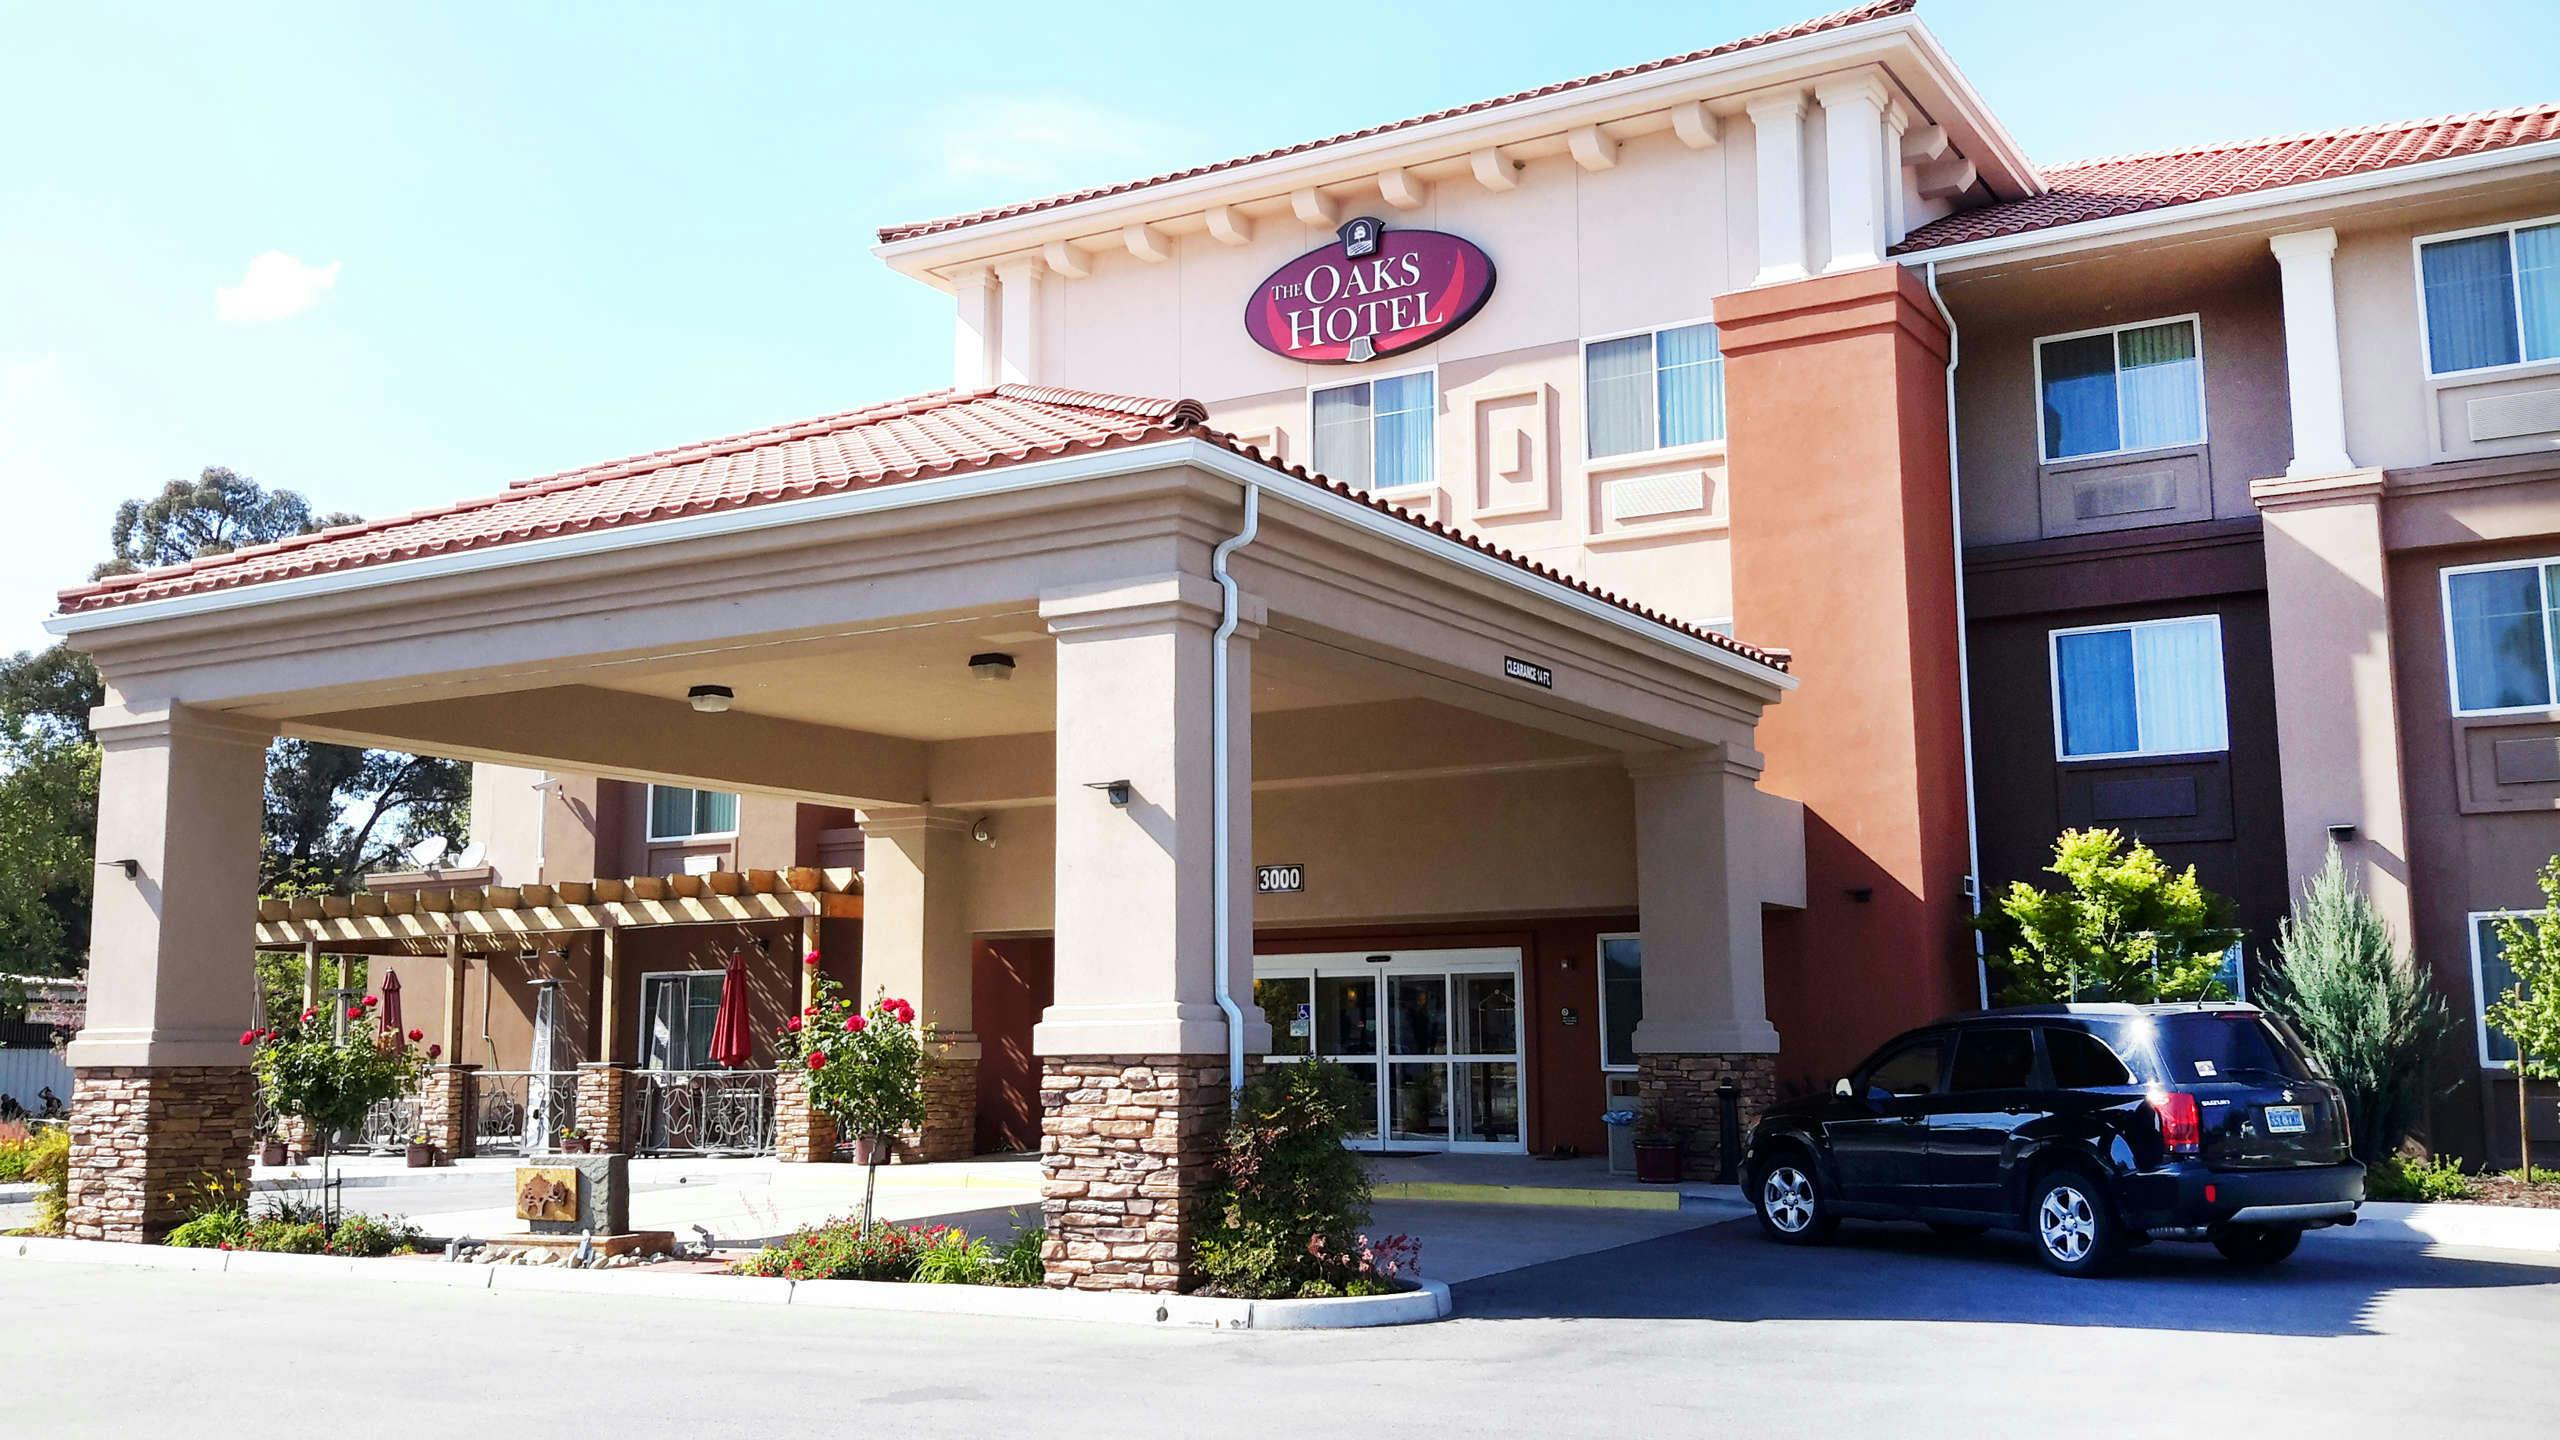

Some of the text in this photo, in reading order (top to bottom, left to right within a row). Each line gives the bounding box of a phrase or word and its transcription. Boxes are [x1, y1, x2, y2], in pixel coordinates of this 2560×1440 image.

[1271, 252, 1420, 304] THE OAKS
[1287, 291, 1443, 350] HOTEL
[1260, 868, 1300, 890] 3000
